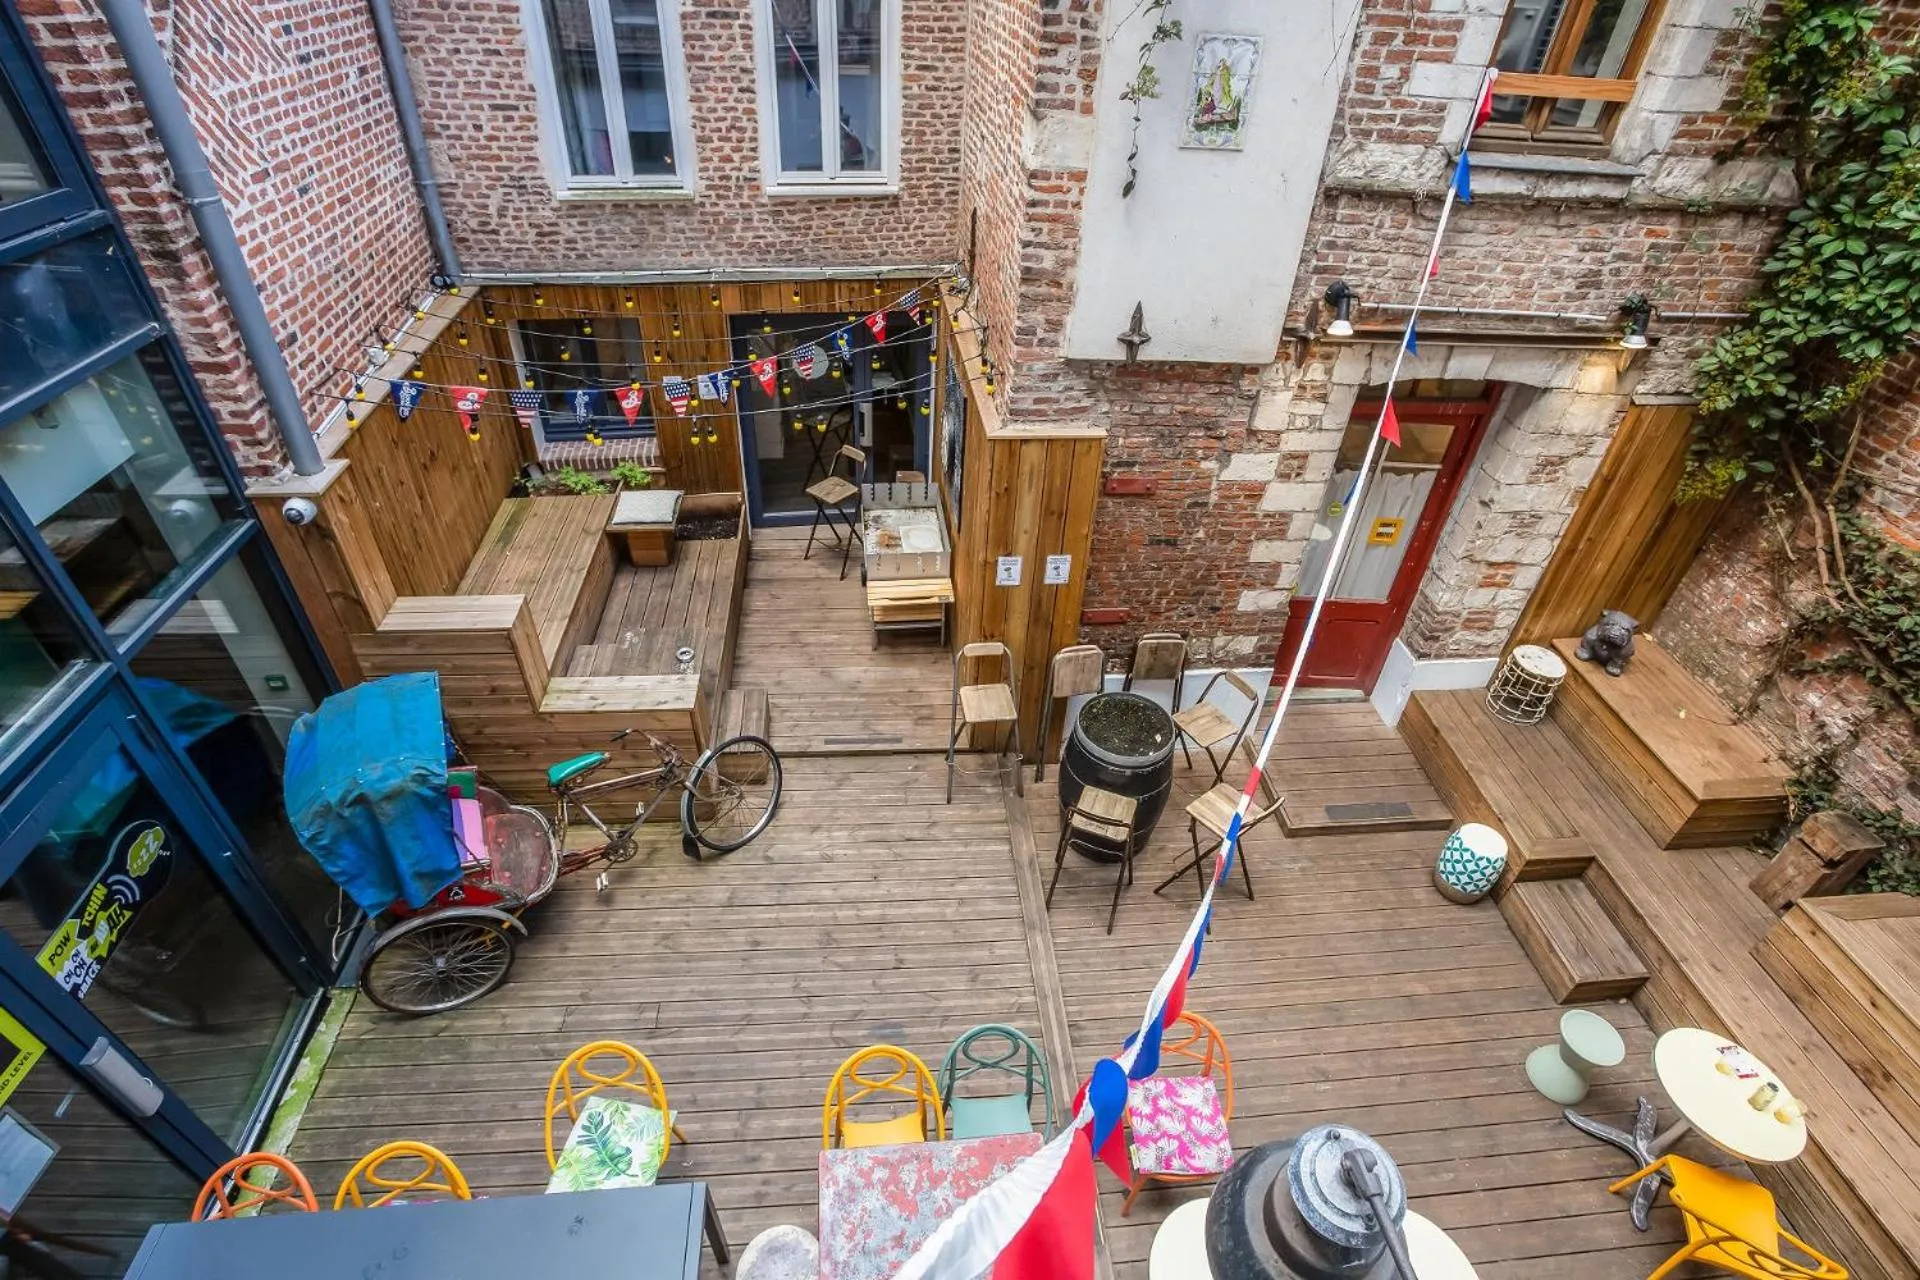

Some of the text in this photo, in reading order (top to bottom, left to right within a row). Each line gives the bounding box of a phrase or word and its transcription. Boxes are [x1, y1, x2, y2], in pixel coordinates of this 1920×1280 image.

[82, 882, 109, 927] TCHIN
[106, 907, 127, 934] AH
[48, 930, 72, 967] POW
[71, 949, 81, 964] OH
[63, 958, 88, 984] OH OH
[10, 1051, 33, 1078] LEVEL
